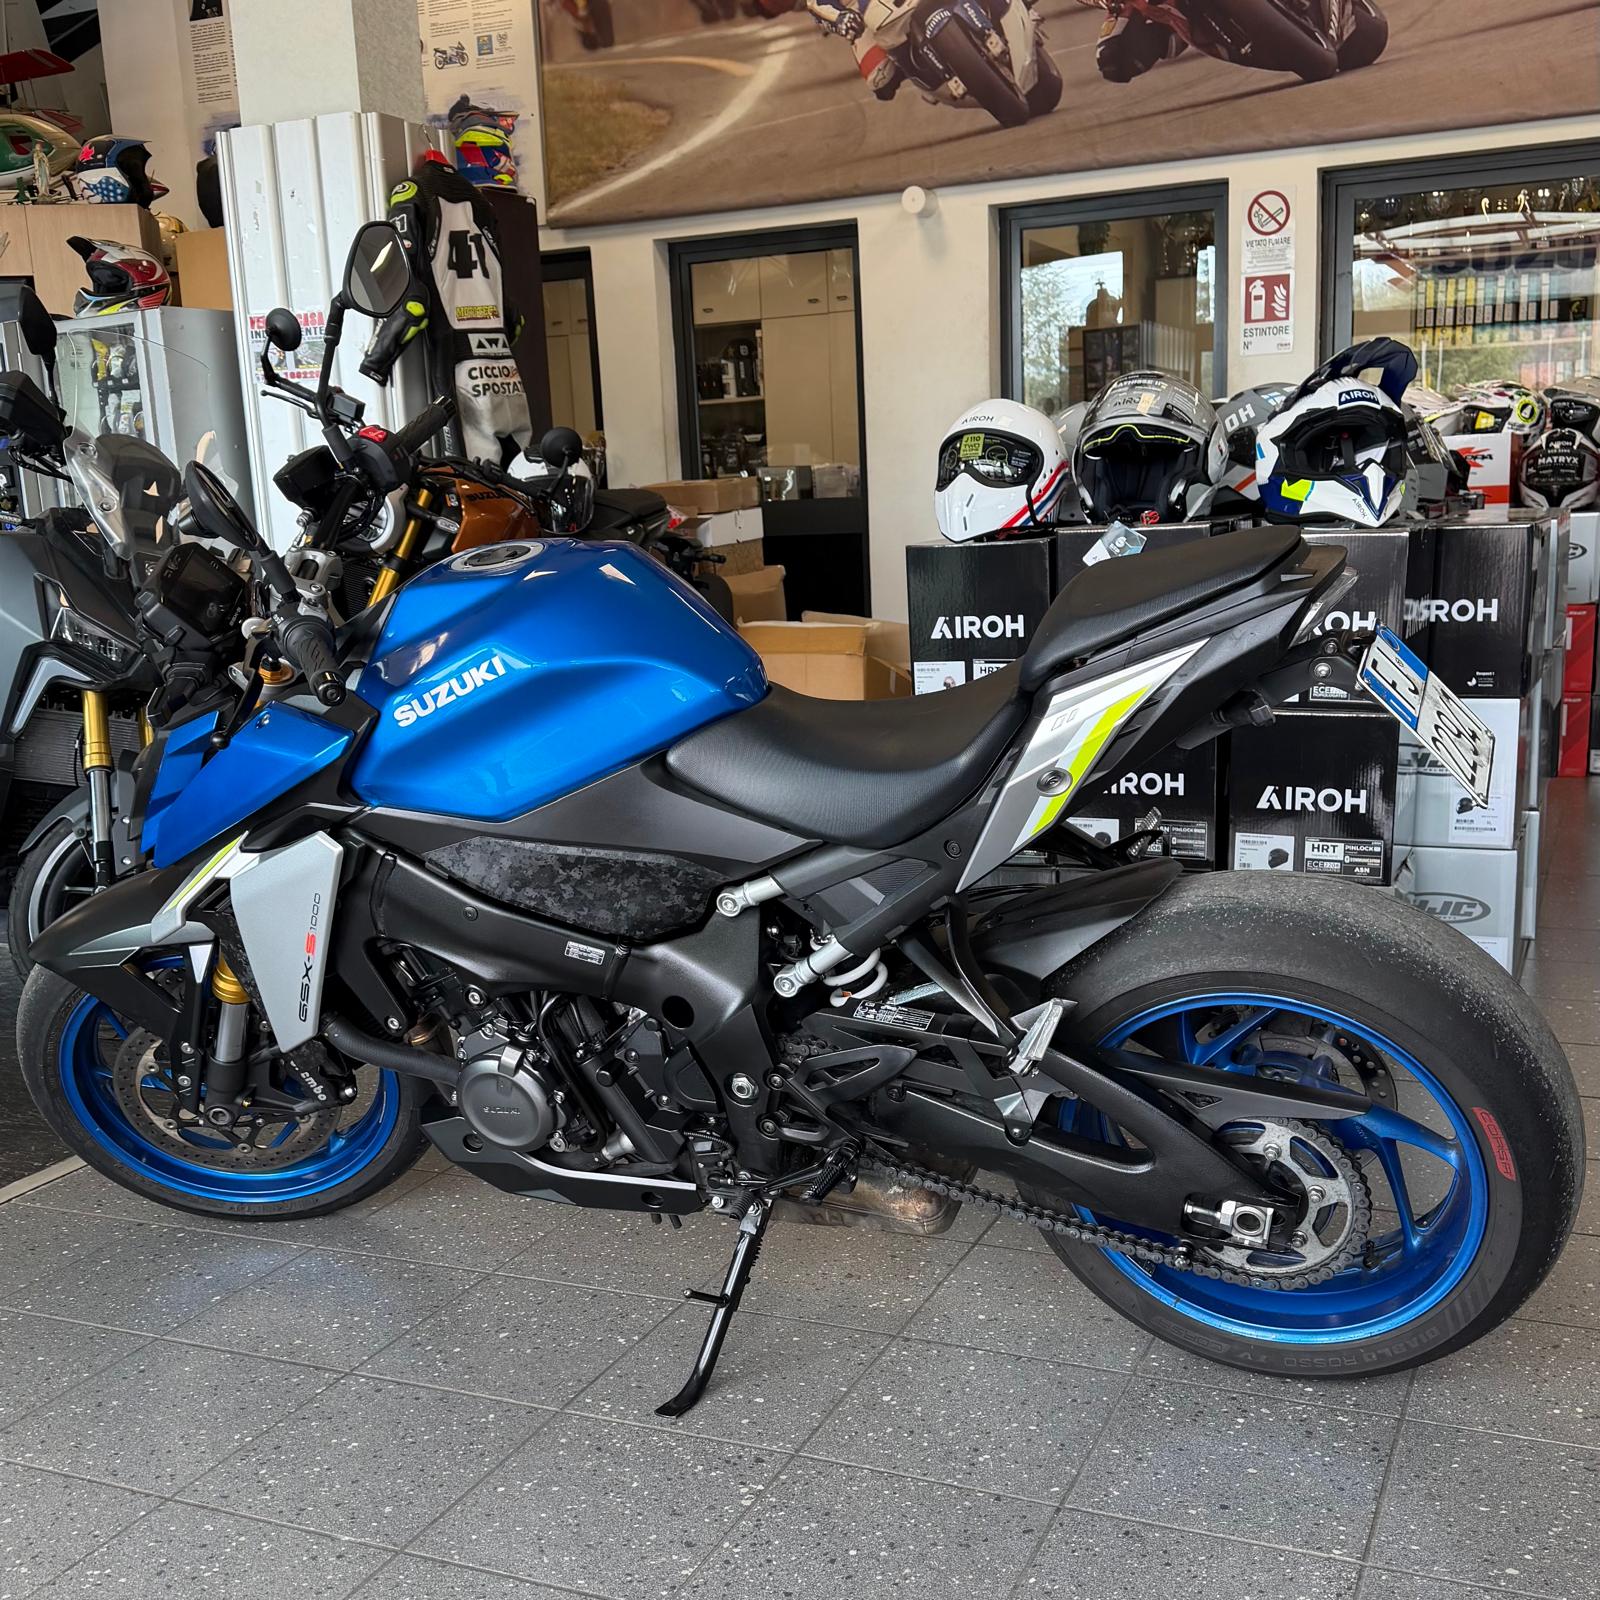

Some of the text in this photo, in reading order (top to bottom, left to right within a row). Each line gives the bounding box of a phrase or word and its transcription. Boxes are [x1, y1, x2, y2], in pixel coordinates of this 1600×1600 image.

[1245, 236, 1291, 248] VIETATO FUMARE
[448, 230, 490, 279] 41
[1243, 325, 1290, 338] ESTINTORE
[468, 365, 510, 380] CICCIO
[1340, 389, 1378, 403] AIROH
[961, 415, 995, 425] AIROH
[1538, 456, 1579, 465] MATRYX
[1352, 498, 1368, 519] AIROH
[930, 614, 1025, 639] AIROH
[393, 655, 506, 727] SUZUKI
[1256, 785, 1367, 814] AIROH
[1311, 843, 1339, 854] HRT
[1345, 844, 1374, 852] PINLOCK
[1307, 860, 1324, 869] ECE
